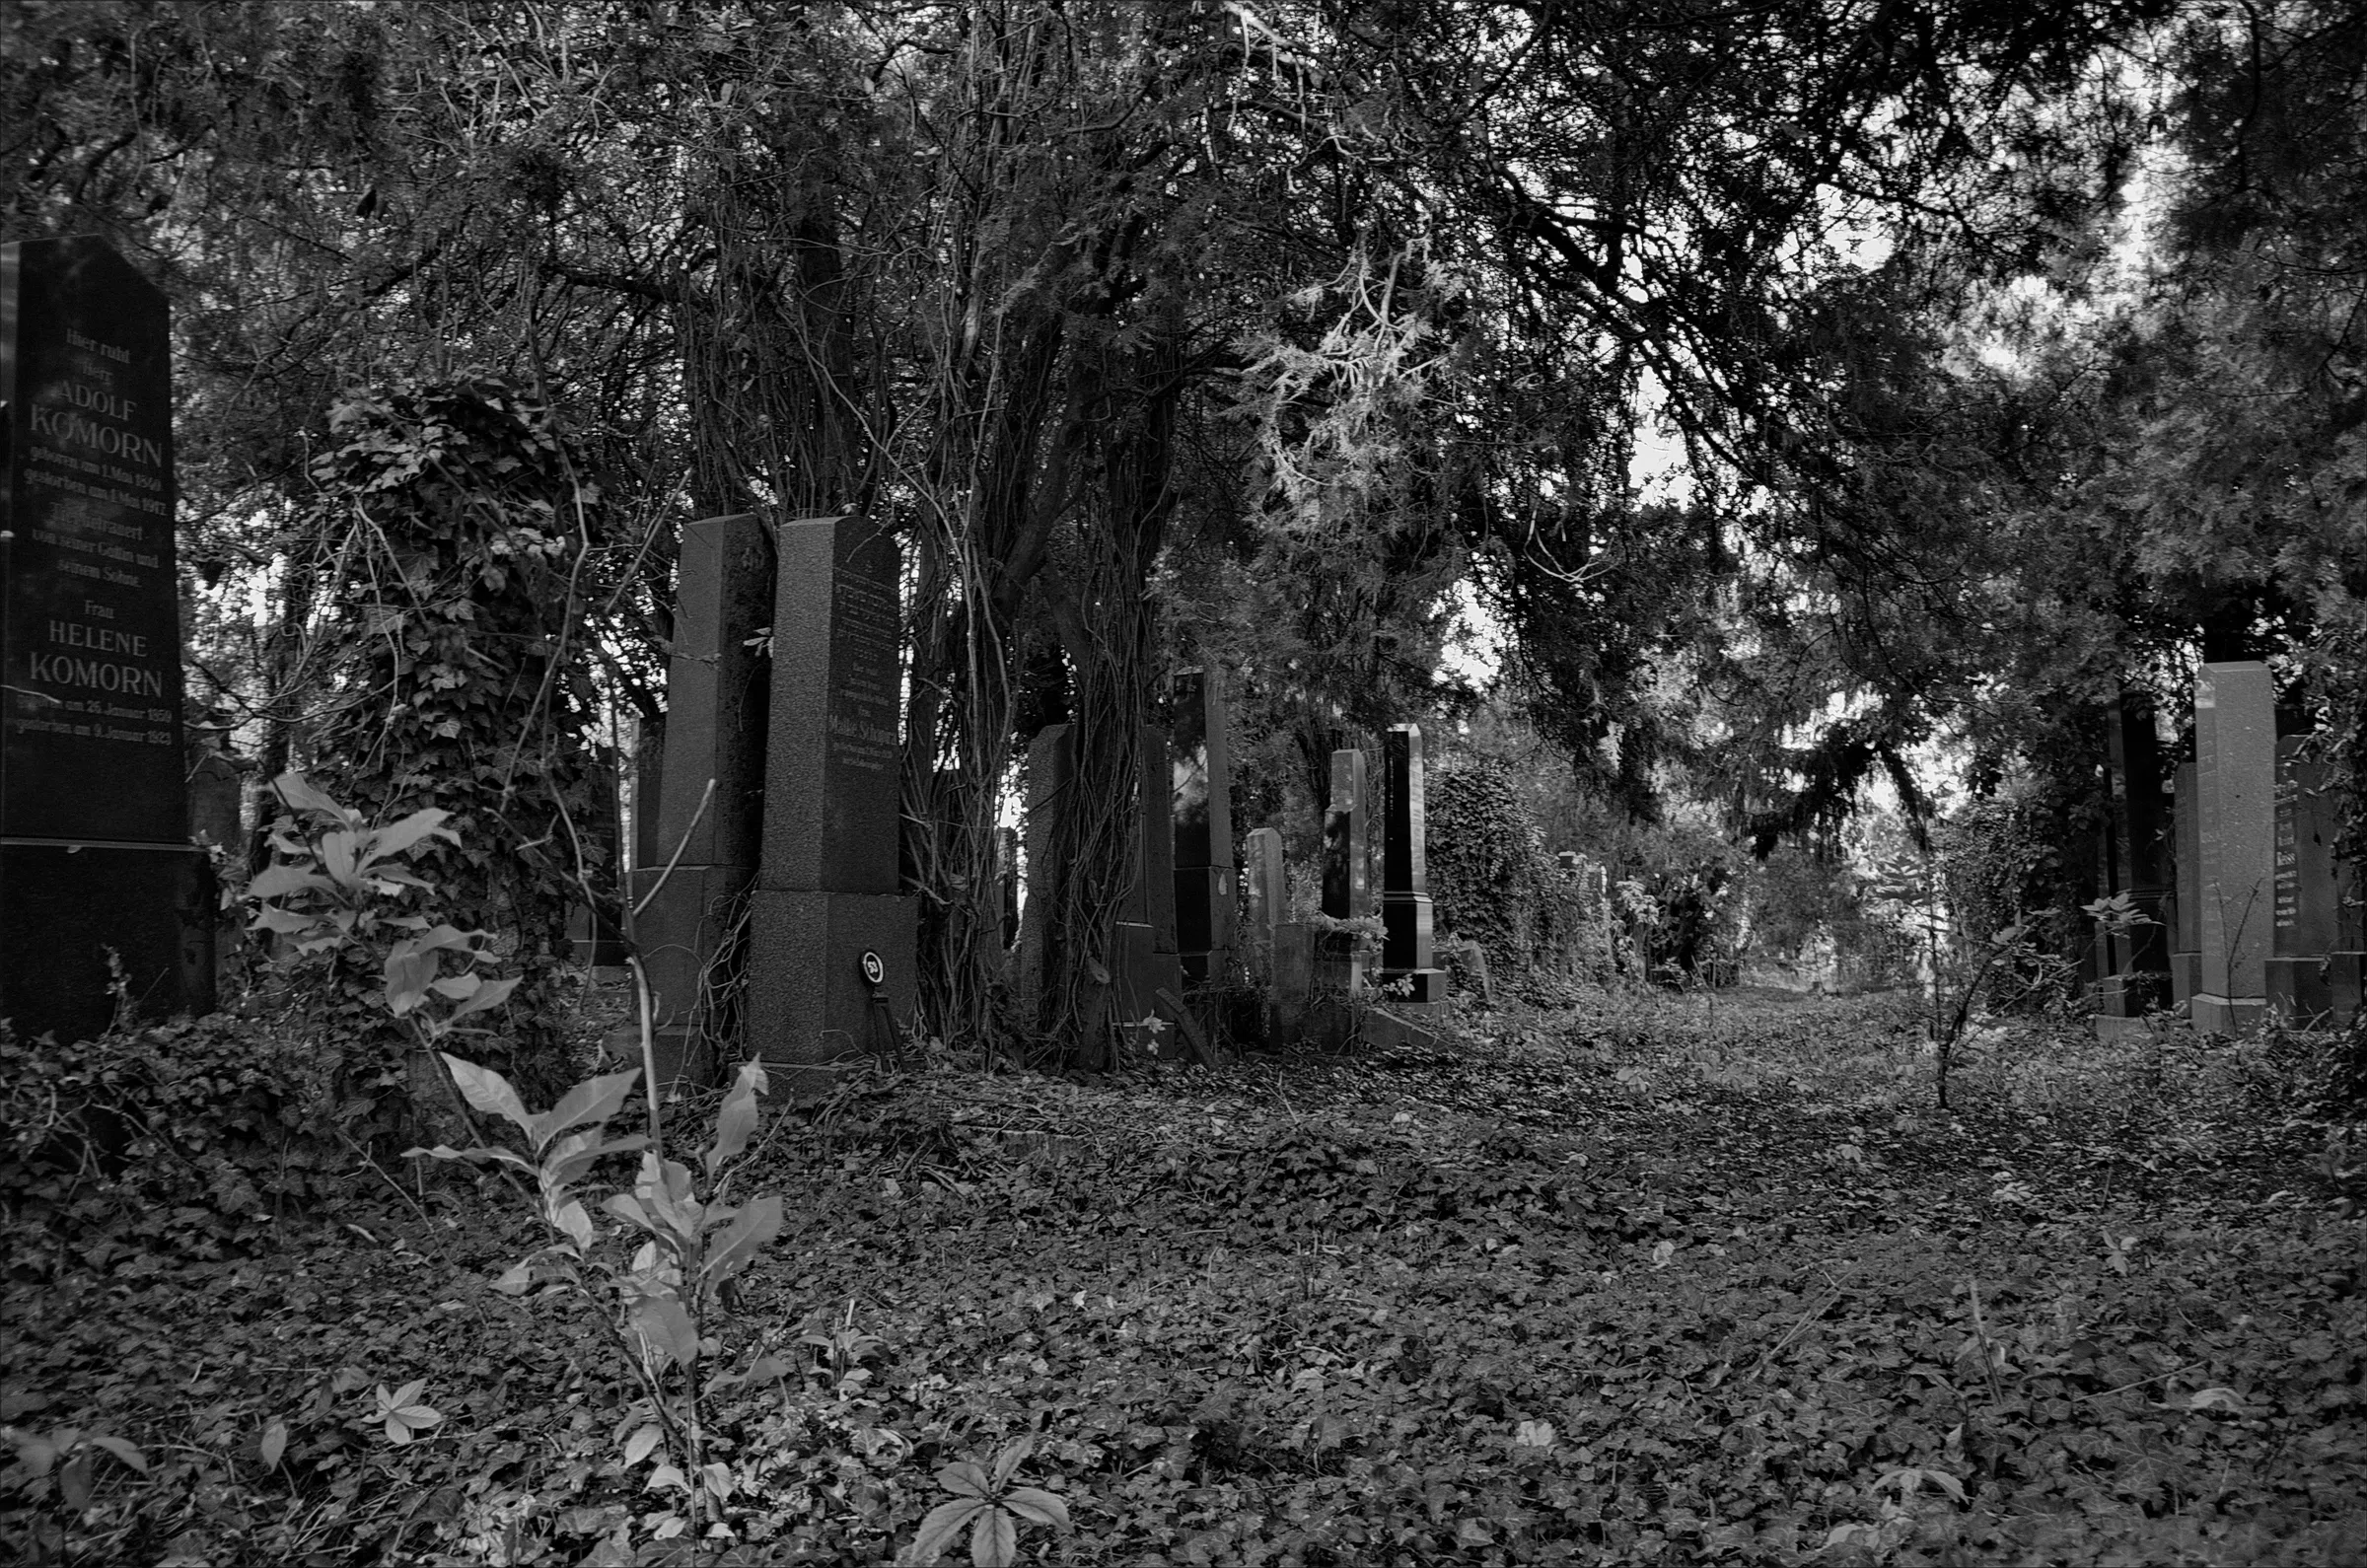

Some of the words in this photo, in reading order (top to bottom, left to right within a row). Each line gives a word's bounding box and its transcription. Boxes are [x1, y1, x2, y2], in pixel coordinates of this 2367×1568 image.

[57, 380, 137, 421] ADOLF
[30, 403, 162, 468] KOMORN
[84, 600, 115, 619] Frau
[48, 619, 148, 658] HELENE
[30, 651, 163, 698] KOMORN
